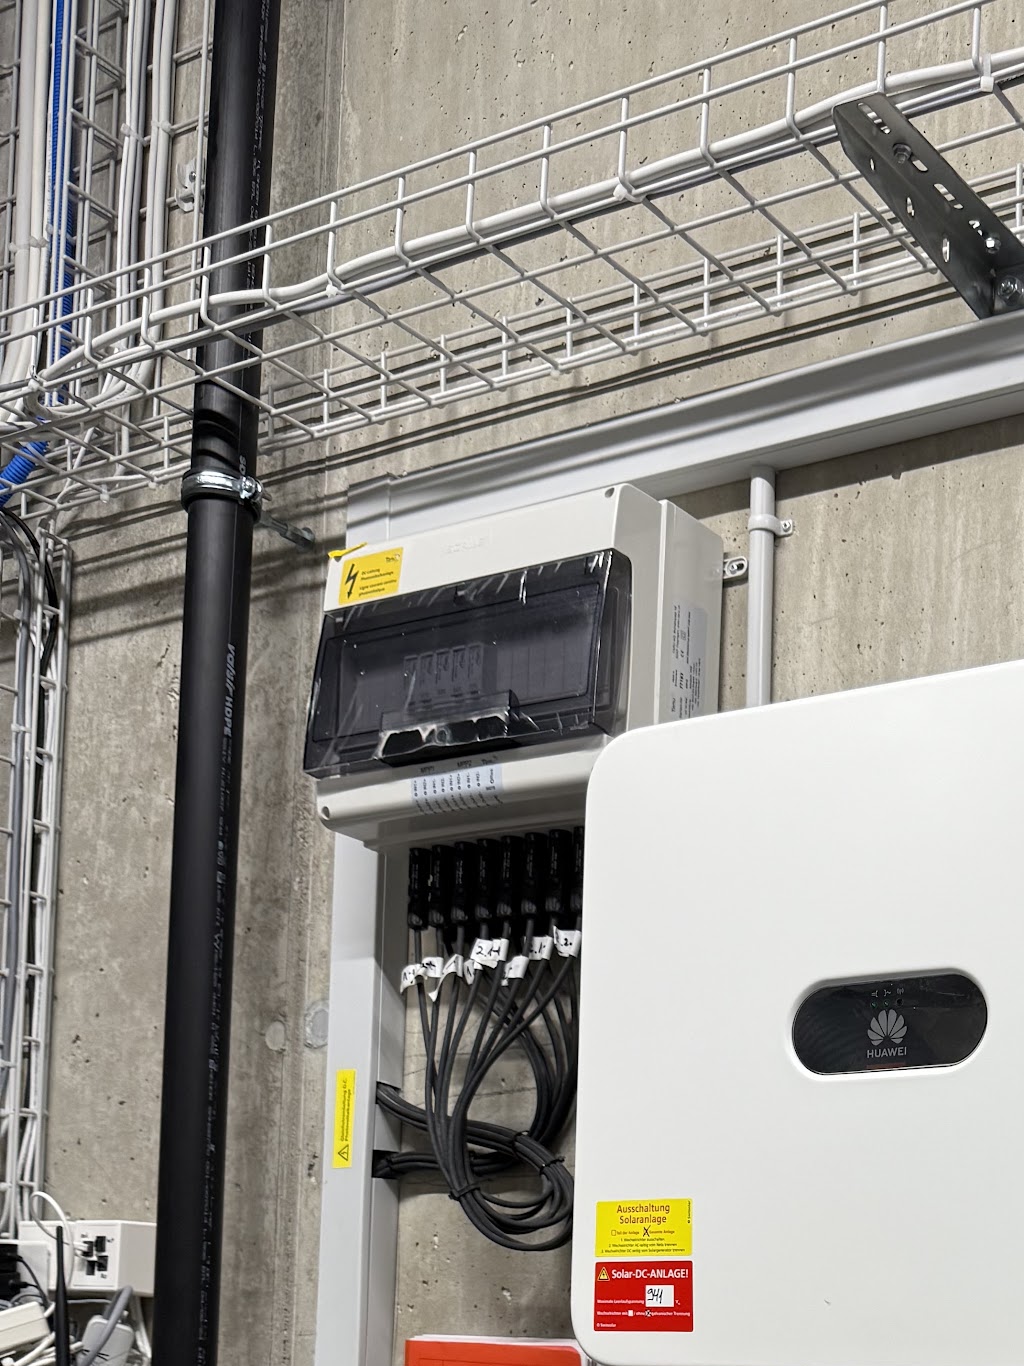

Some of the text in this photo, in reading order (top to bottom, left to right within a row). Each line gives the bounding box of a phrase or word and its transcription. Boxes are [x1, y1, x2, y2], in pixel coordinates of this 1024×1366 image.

[224, 695, 234, 738] HDPE
[866, 1047, 907, 1059] HUAWEI
[616, 1203, 670, 1214] Ausschaltung
[619, 1214, 667, 1225] Solaranlage
[611, 1269, 689, 1279] Solar-DC-ANLAGE!
